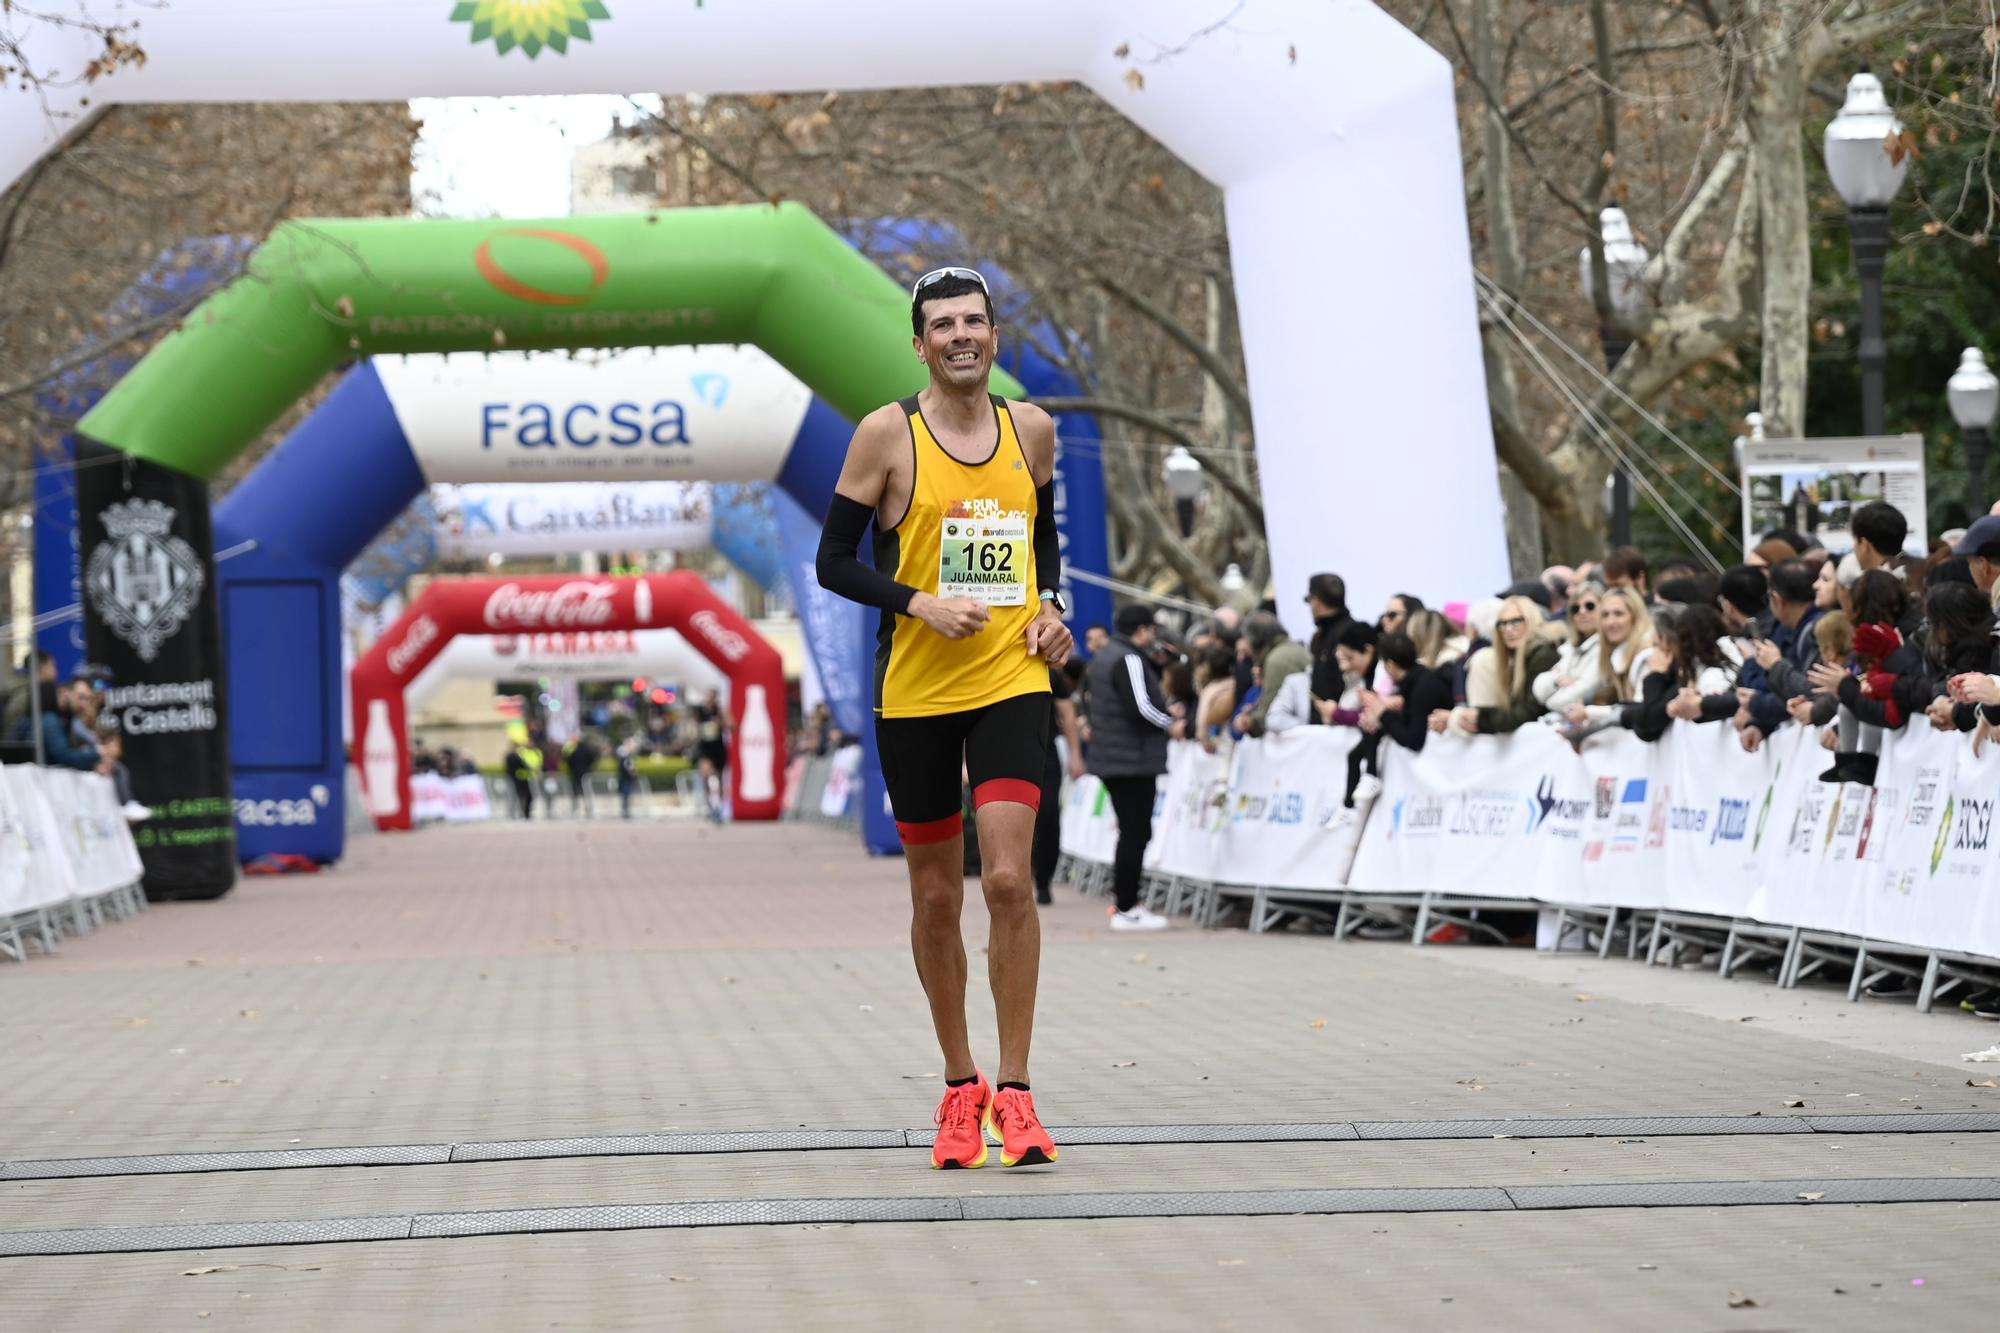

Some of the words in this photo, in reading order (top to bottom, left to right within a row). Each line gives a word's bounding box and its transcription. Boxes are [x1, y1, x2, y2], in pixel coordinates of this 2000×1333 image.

[973, 498, 999, 512] RUN
[962, 542, 1013, 572] 162
[950, 572, 1018, 584] JUANMARAL
[105, 679, 215, 709] juntament
